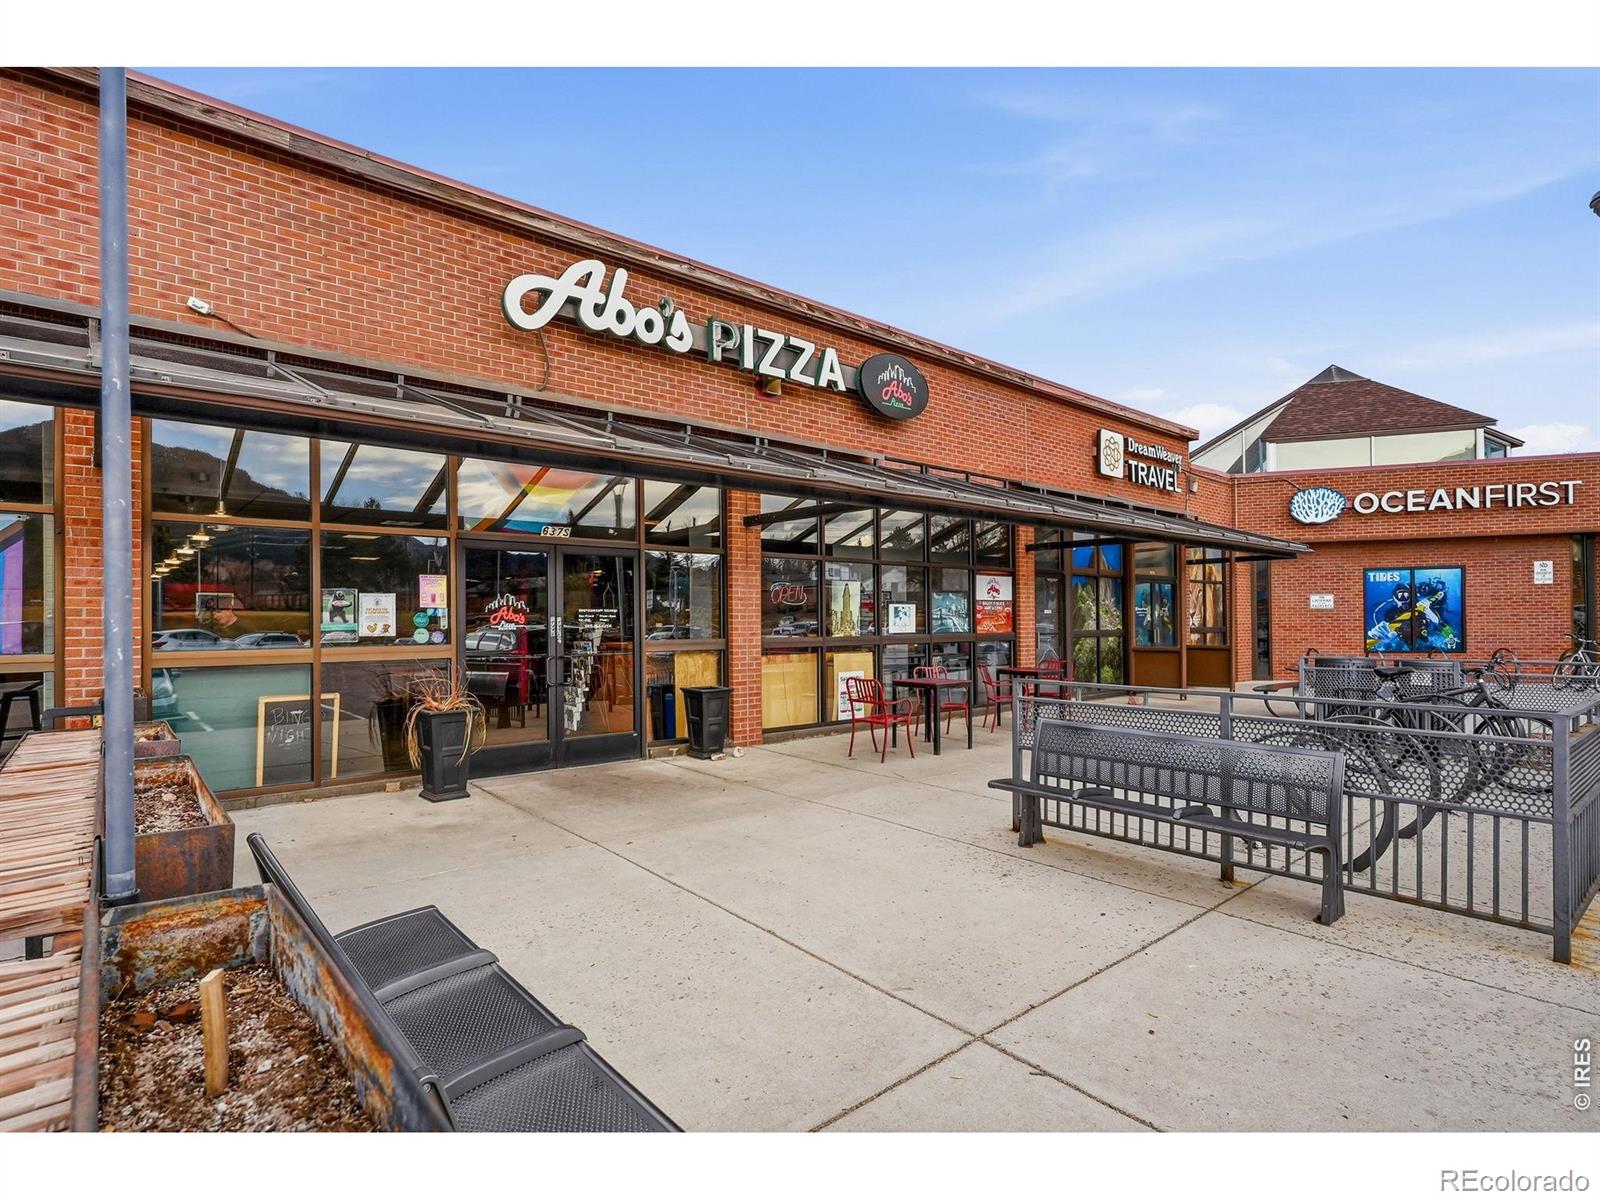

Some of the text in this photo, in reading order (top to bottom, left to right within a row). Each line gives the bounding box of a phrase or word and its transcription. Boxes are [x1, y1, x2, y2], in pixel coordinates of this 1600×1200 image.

[503, 259, 847, 392] Abo's PIZZA
[882, 380, 912, 406] Abo's
[1128, 437, 1182, 465] DreamWeaver
[1128, 459, 1182, 492] TRAVEL
[1368, 572, 1400, 582] TIDES
[771, 584, 804, 604] OPEN
[490, 606, 526, 625] Abo's
